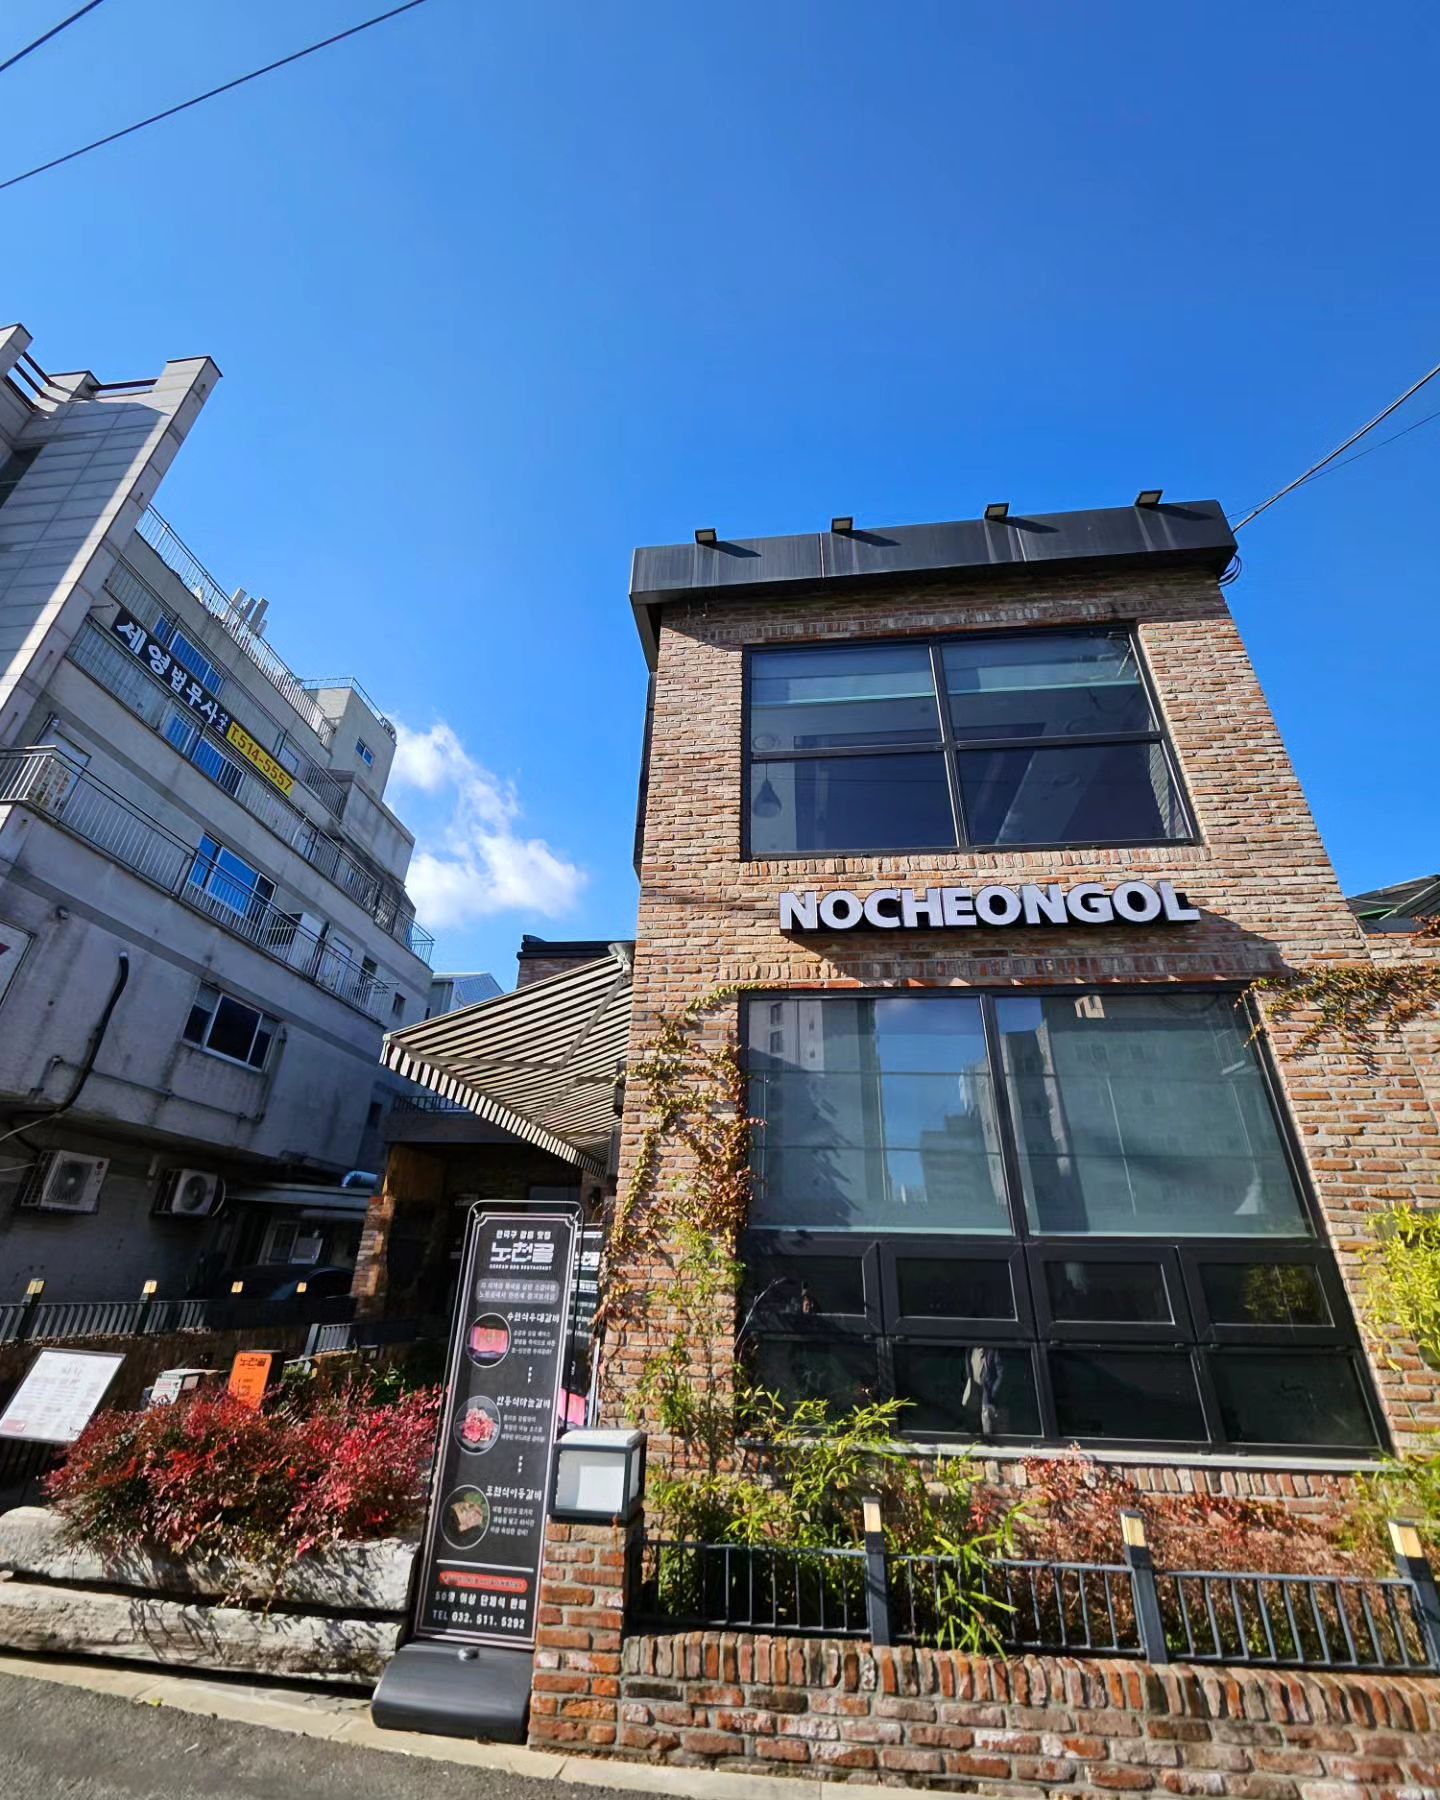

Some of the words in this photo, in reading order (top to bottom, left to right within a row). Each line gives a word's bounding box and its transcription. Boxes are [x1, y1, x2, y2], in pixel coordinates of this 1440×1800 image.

[117, 621, 218, 723] 세영법무사
[231, 725, 293, 790] T.514-5557
[779, 880, 1200, 930] NOCHEONGOL
[490, 1241, 555, 1263] 노천골
[433, 1610, 448, 1620] TEL
